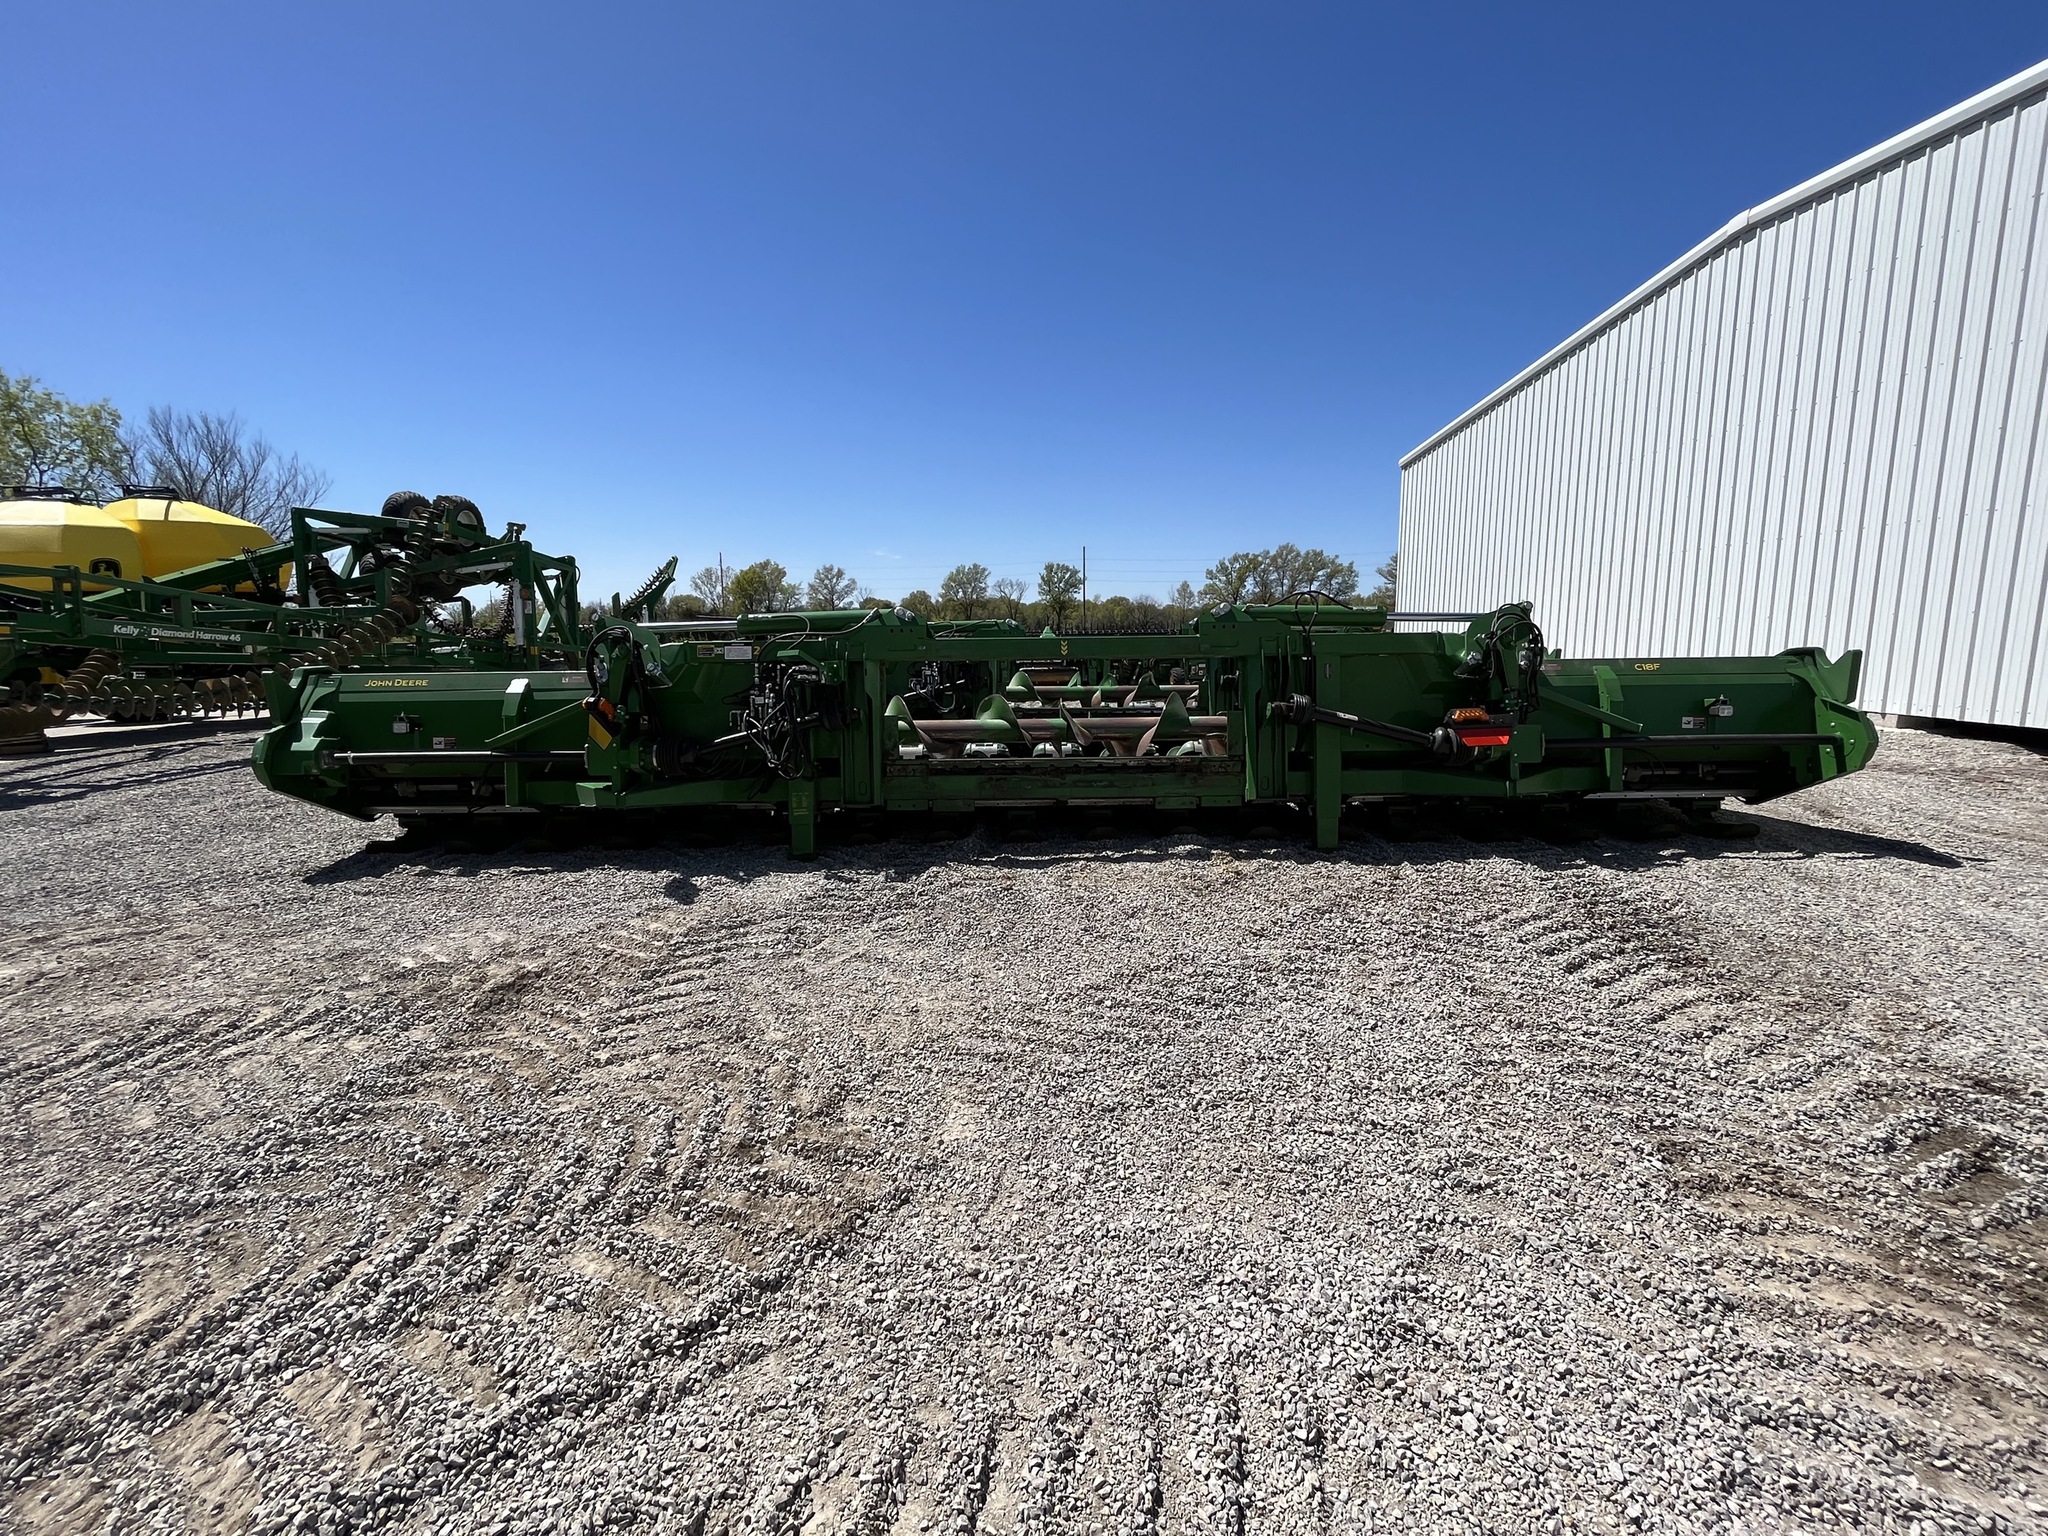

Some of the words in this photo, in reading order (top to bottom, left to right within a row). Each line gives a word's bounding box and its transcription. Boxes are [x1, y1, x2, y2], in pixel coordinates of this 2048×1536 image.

[113, 624, 140, 637] Kelly
[150, 627, 195, 639] Diamond
[196, 631, 230, 641] Harrow
[229, 634, 241, 642] 46
[1634, 663, 1661, 671] C18F
[364, 679, 393, 687] JOHN
[394, 678, 429, 687] DEERE
